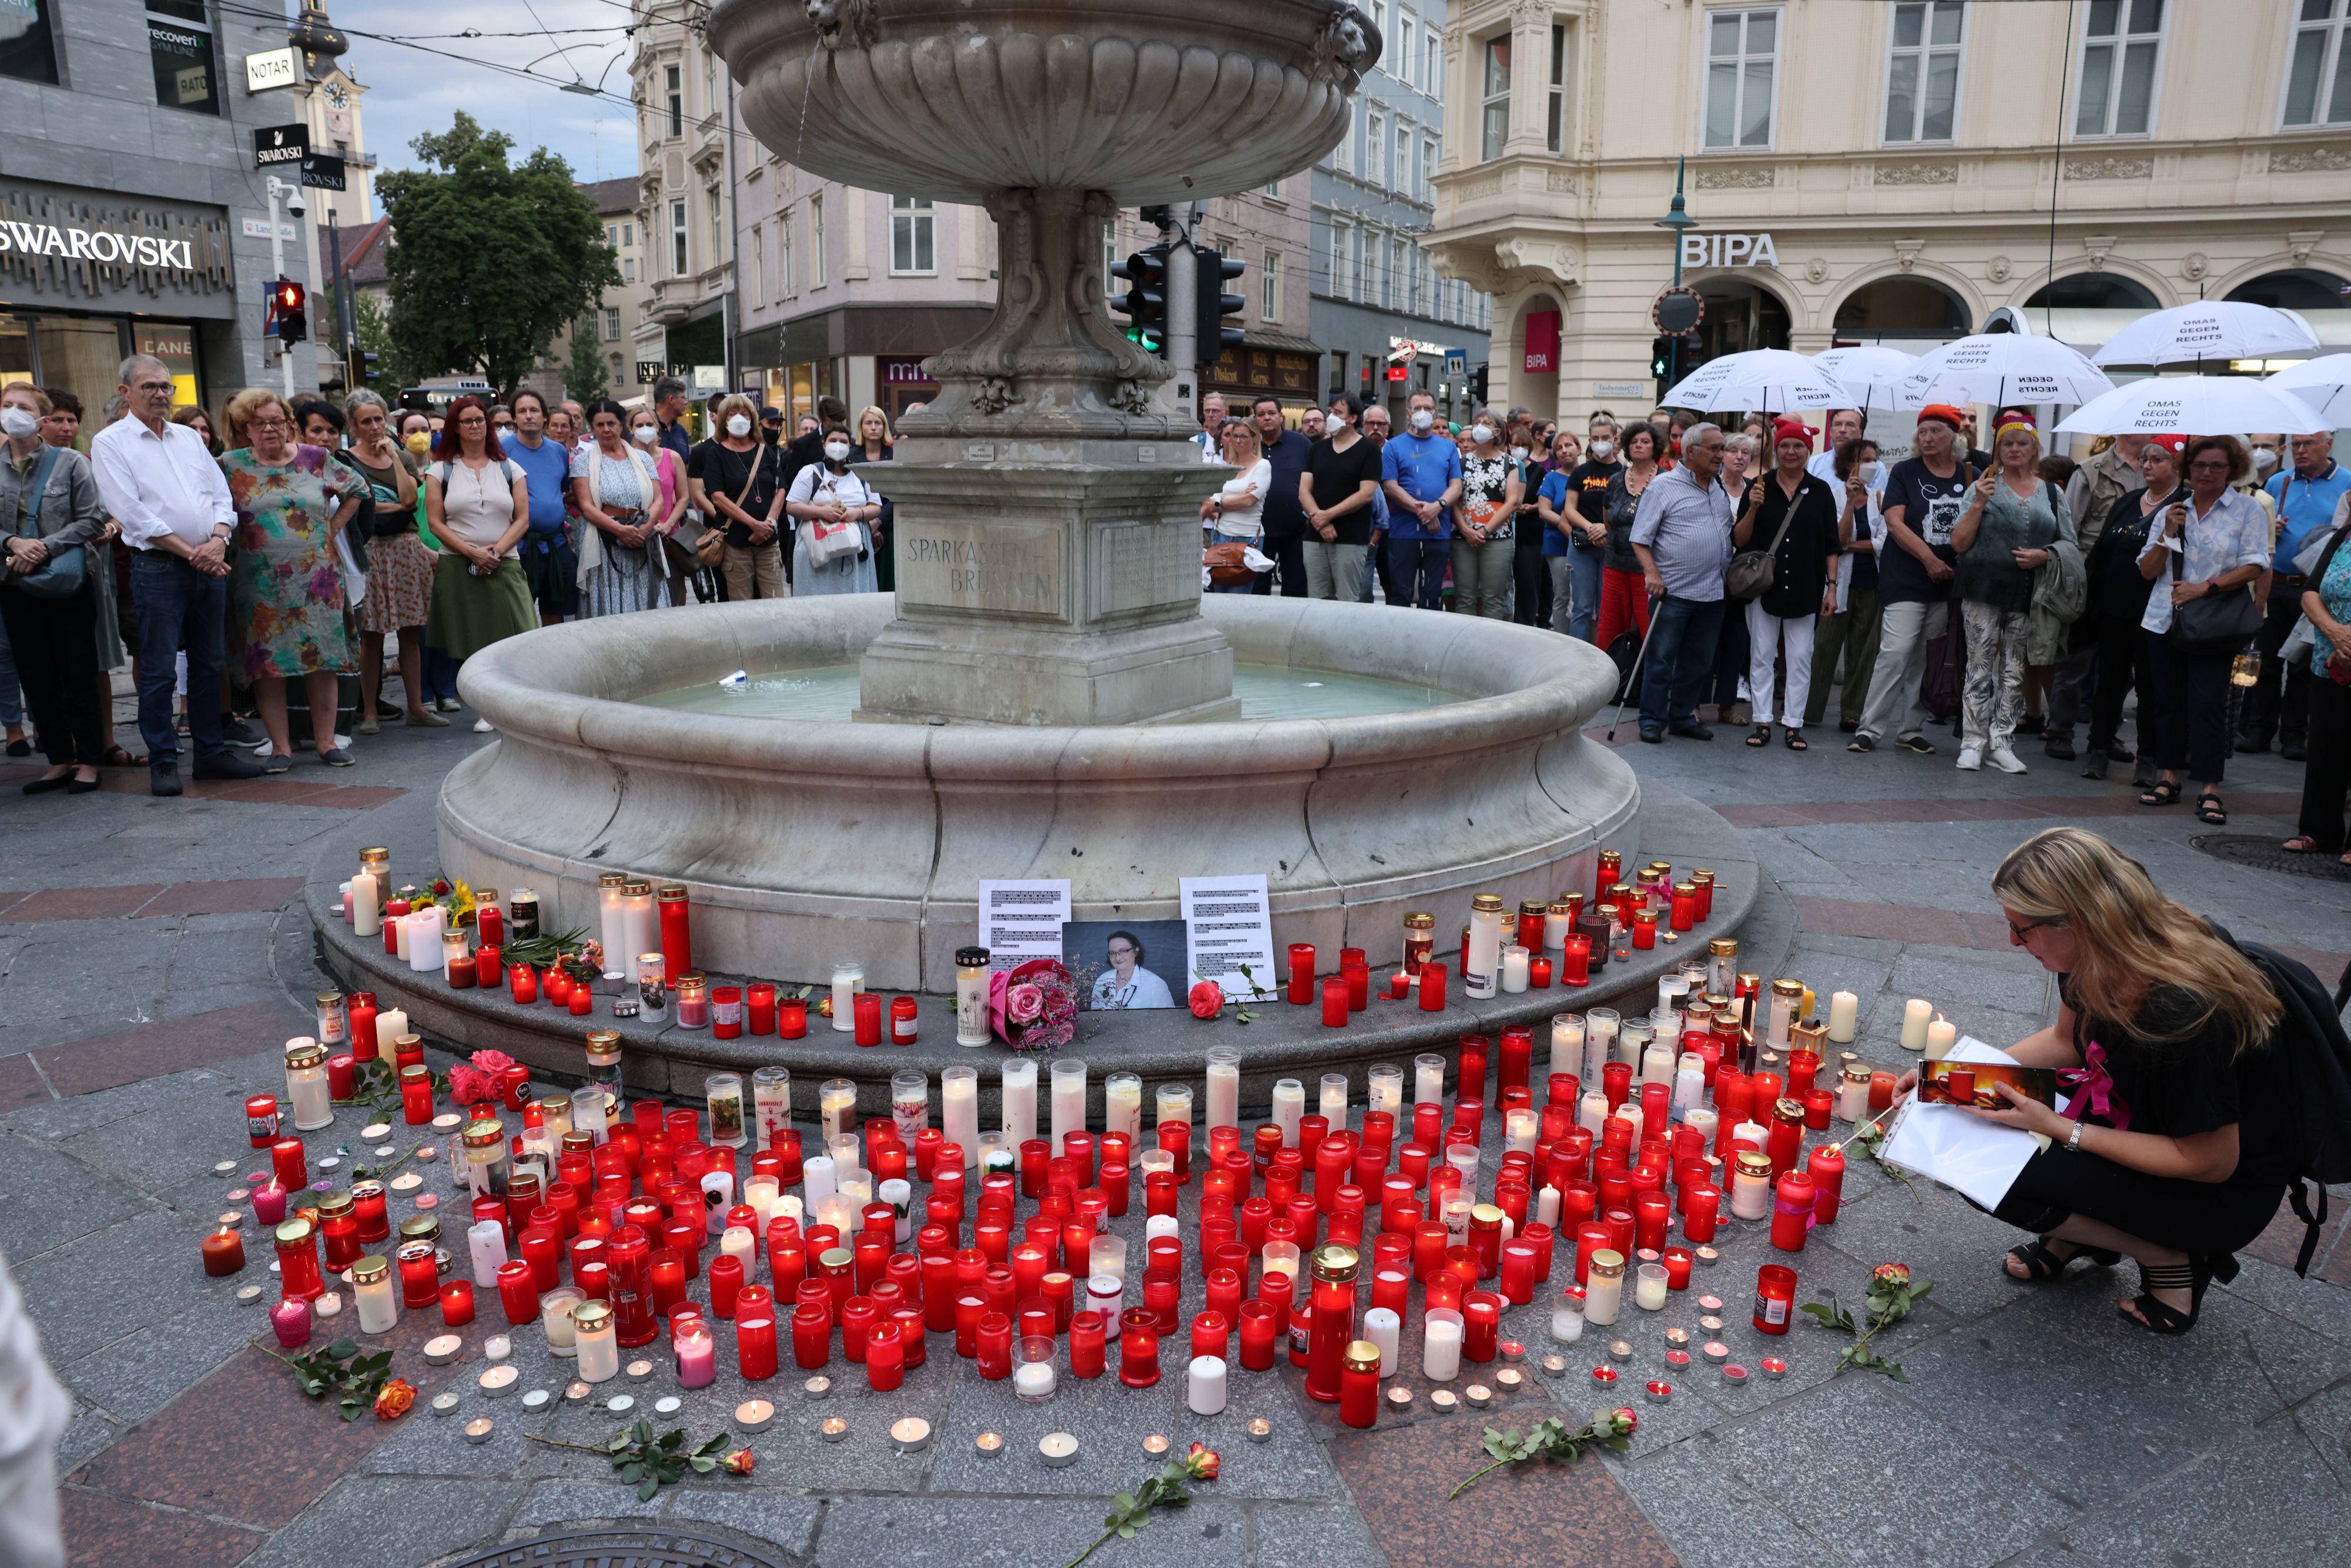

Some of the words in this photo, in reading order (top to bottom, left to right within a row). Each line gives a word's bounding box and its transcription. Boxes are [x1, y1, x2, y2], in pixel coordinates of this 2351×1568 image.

[150, 39, 173, 52] GYM
[173, 44, 195, 57] LINZ
[251, 59, 290, 79] NOTAR
[258, 146, 302, 163] SWAROVSKI
[302, 172, 343, 188] ROVSKI
[0, 220, 193, 270] SWAROVSKI
[1680, 233, 1779, 268] BIPA
[2176, 334, 2222, 343] RECHTS
[2180, 326, 2219, 334] GEGEN
[1526, 354, 1548, 368] BIPA
